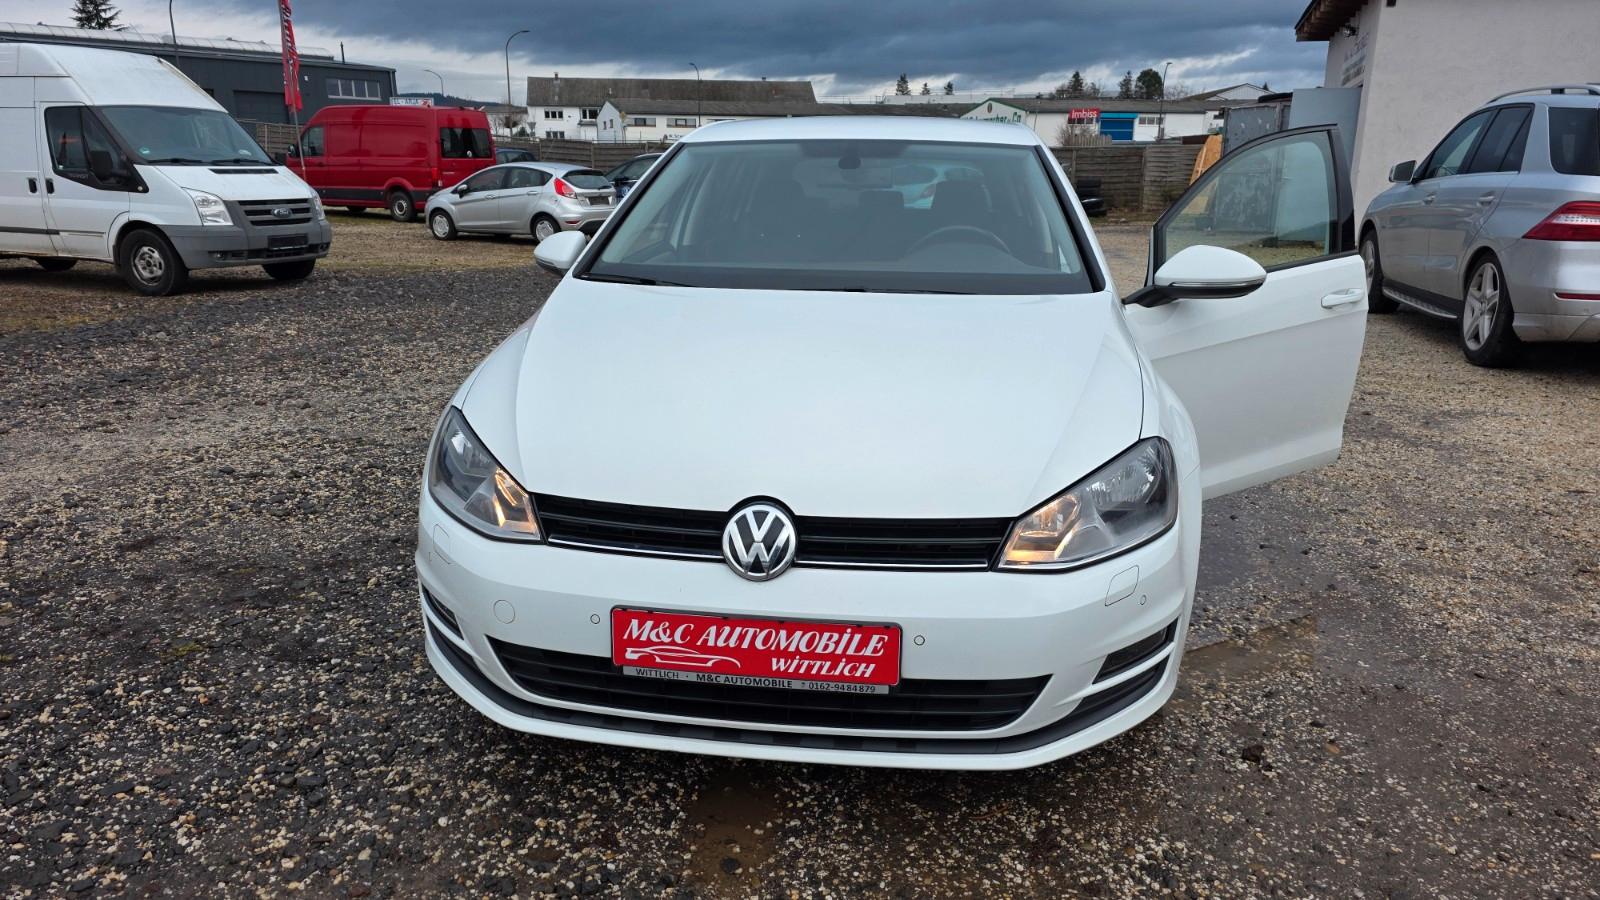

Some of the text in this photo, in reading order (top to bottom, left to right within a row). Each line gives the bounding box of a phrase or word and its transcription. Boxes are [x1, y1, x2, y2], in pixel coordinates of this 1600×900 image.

[1071, 109, 1097, 119] Imbiss
[623, 618, 695, 644] M&C
[635, 668, 876, 693] WITTLICH M&C AUTOMOBILE 0162-9484879
